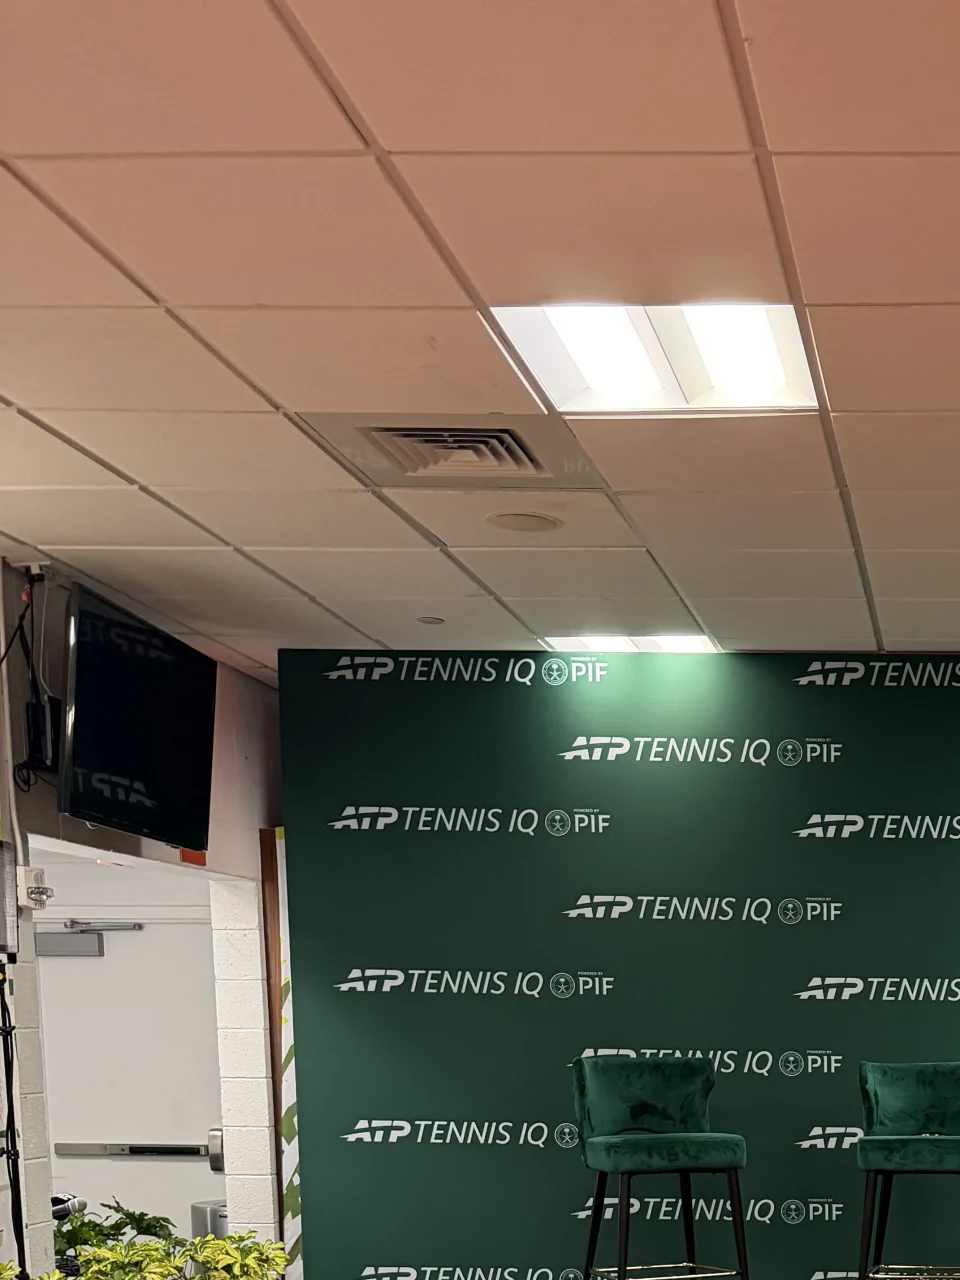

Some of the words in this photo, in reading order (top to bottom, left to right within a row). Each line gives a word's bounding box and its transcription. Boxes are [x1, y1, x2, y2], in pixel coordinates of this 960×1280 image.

[321, 656, 395, 681] ATP
[398, 657, 499, 682] TENNIS
[505, 658, 536, 686] IQ
[571, 662, 609, 683] PIF
[791, 661, 866, 686] ATP
[555, 736, 631, 761] ATP
[633, 737, 735, 763] TENNIS
[740, 738, 771, 767] IQ
[806, 743, 843, 763] PIF
[325, 806, 399, 830] ATP
[402, 806, 503, 833] TENNIS
[508, 808, 539, 836] IQ
[574, 814, 611, 833] PIF
[790, 814, 865, 838] ATP
[559, 894, 634, 919] ATP
[636, 895, 736, 921] TENNIS
[741, 897, 772, 925] IQ
[806, 902, 843, 921] PIF
[332, 968, 405, 992] ATP
[408, 969, 508, 995] TENNIS
[513, 971, 544, 998] IQ
[578, 976, 615, 996] PIF
[791, 977, 864, 1000] ATP
[743, 1051, 773, 1077] IQ
[807, 1055, 843, 1074] PIF
[338, 1119, 412, 1143] ATP
[414, 1120, 513, 1145] TENNIS
[518, 1122, 549, 1148] IQ
[792, 1126, 865, 1150] ATP
[745, 1198, 775, 1224] IQ
[808, 1203, 844, 1221] PIF
